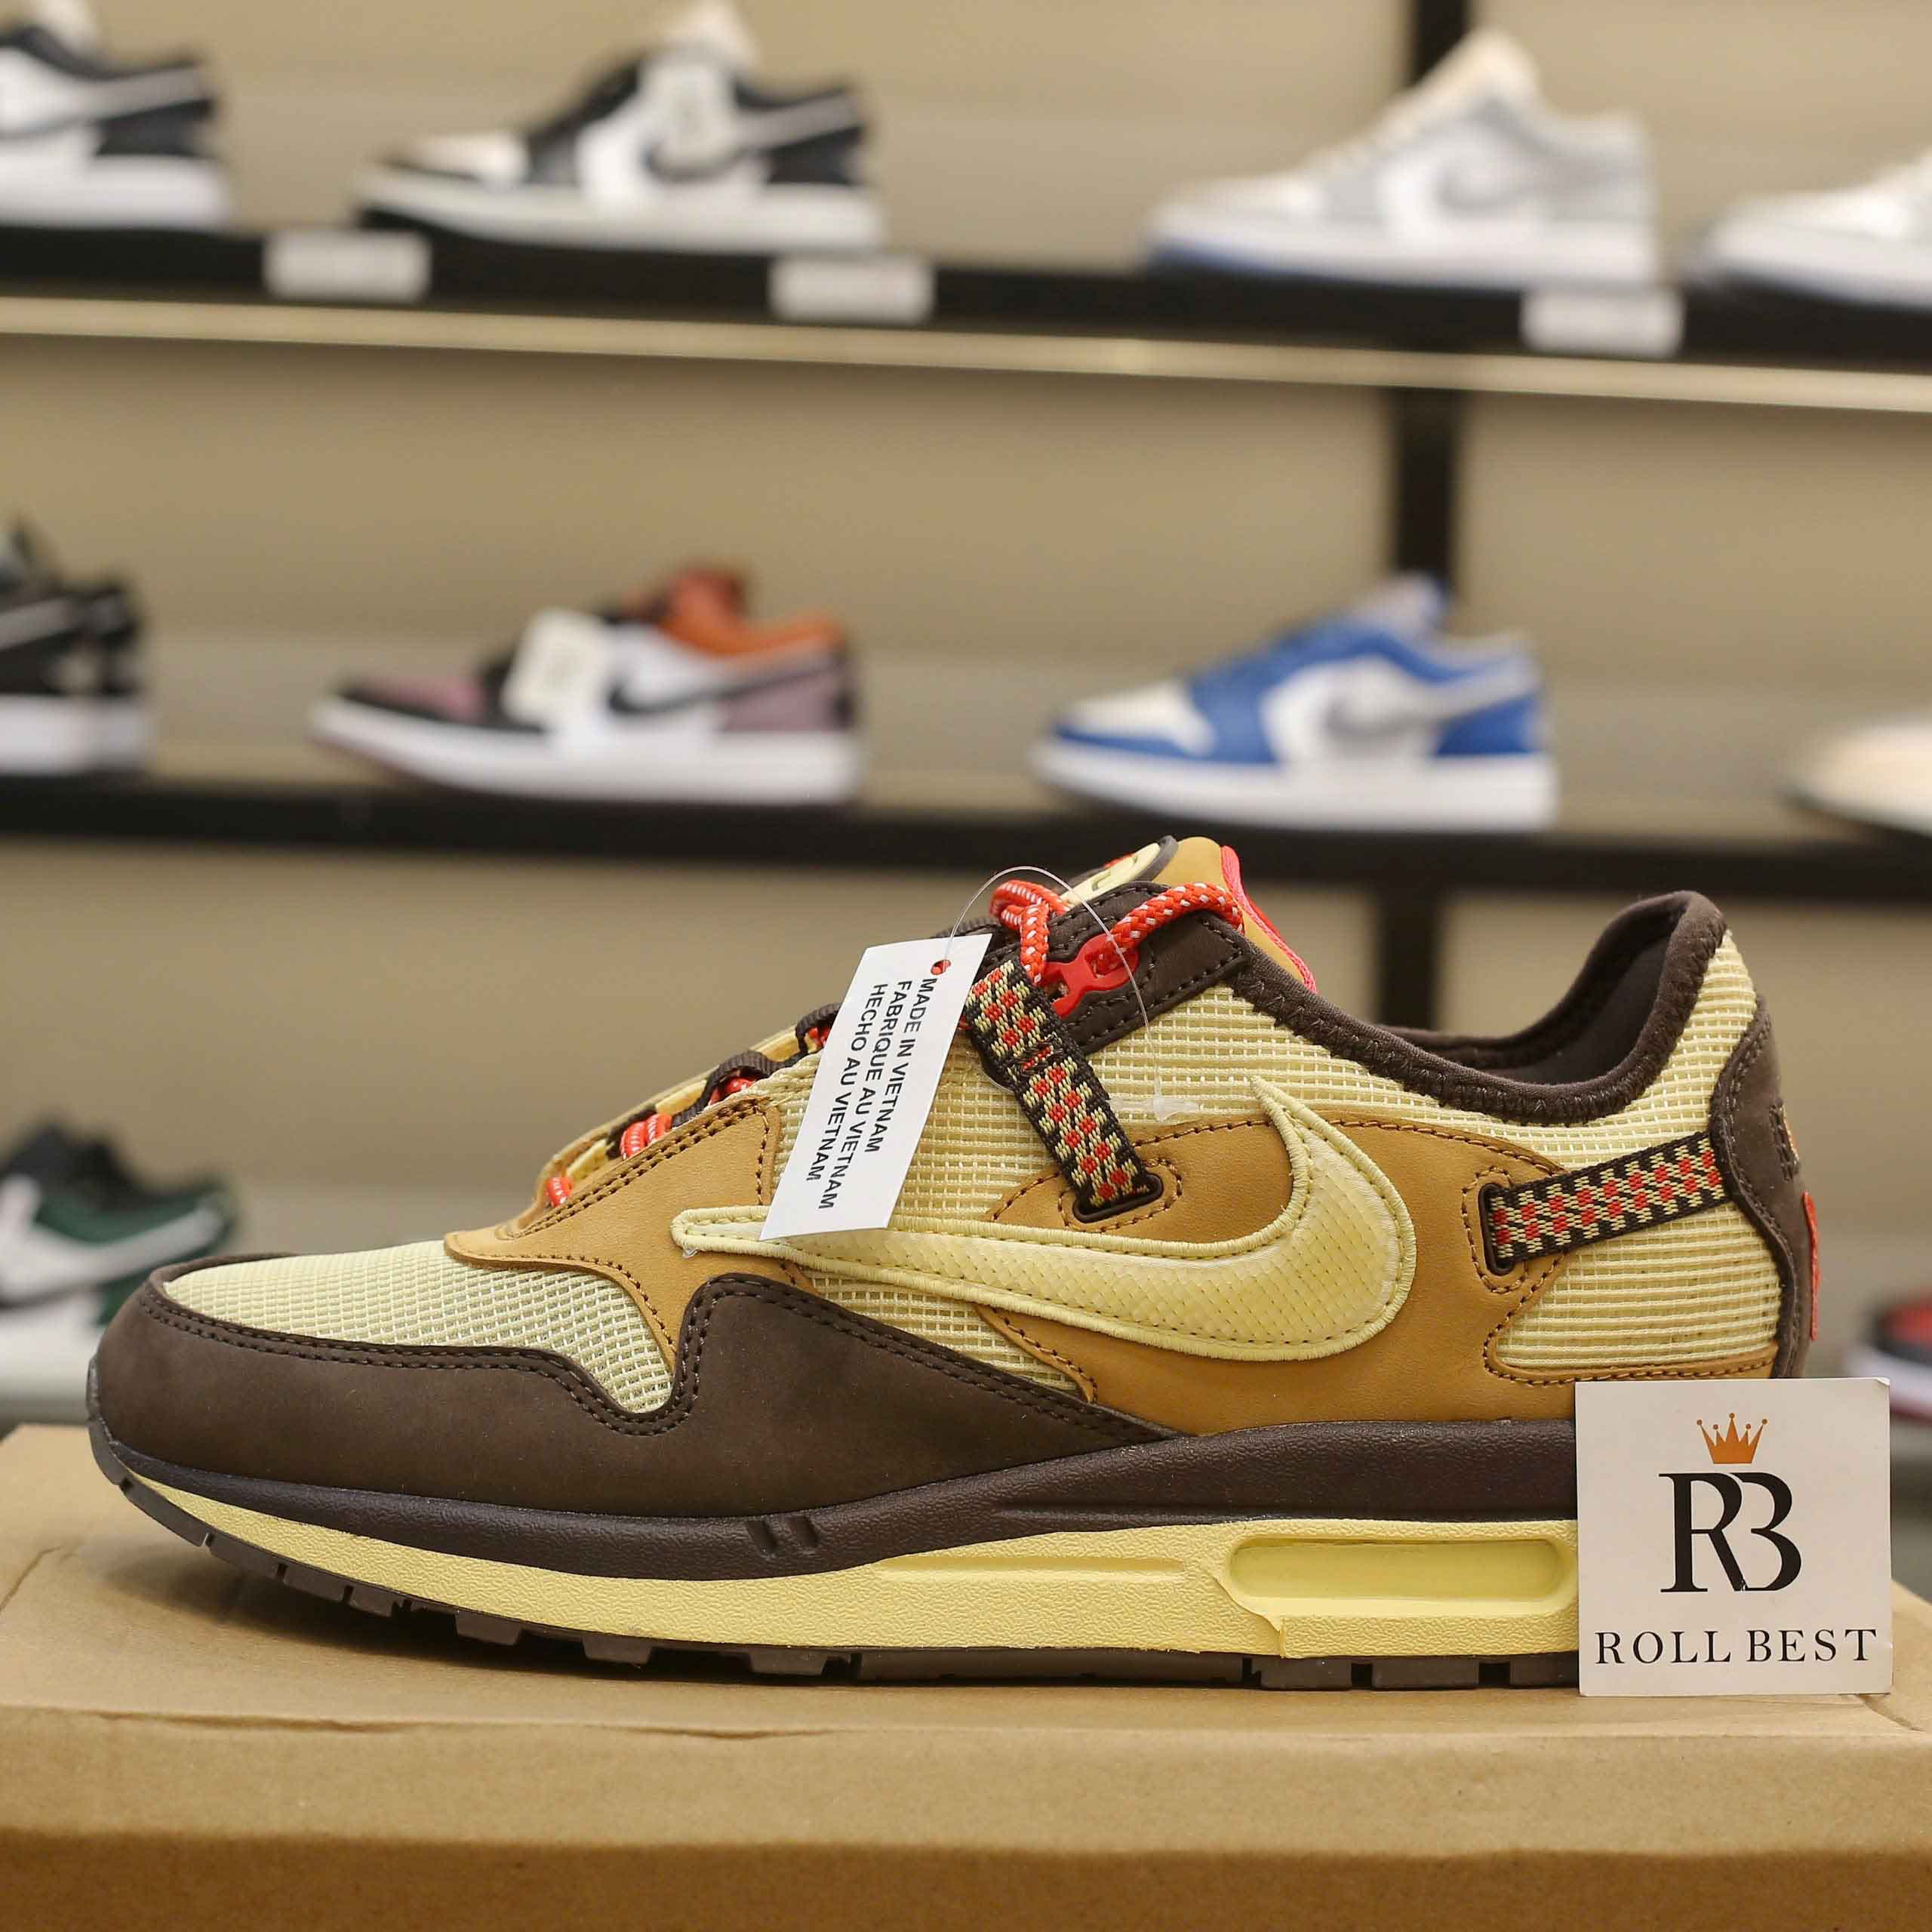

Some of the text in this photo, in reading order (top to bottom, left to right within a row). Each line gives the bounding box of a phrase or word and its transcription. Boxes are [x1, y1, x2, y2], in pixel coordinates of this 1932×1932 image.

[807, 984, 888, 1180] HECHO AU VIETNAM
[819, 981, 912, 1208] FABRIQUE AU VIETNAM
[865, 978, 937, 1152] MADE IN VIETNAM
[1659, 1472, 1801, 1592] RB
[1595, 1629, 1876, 1663] ROLL BEST
